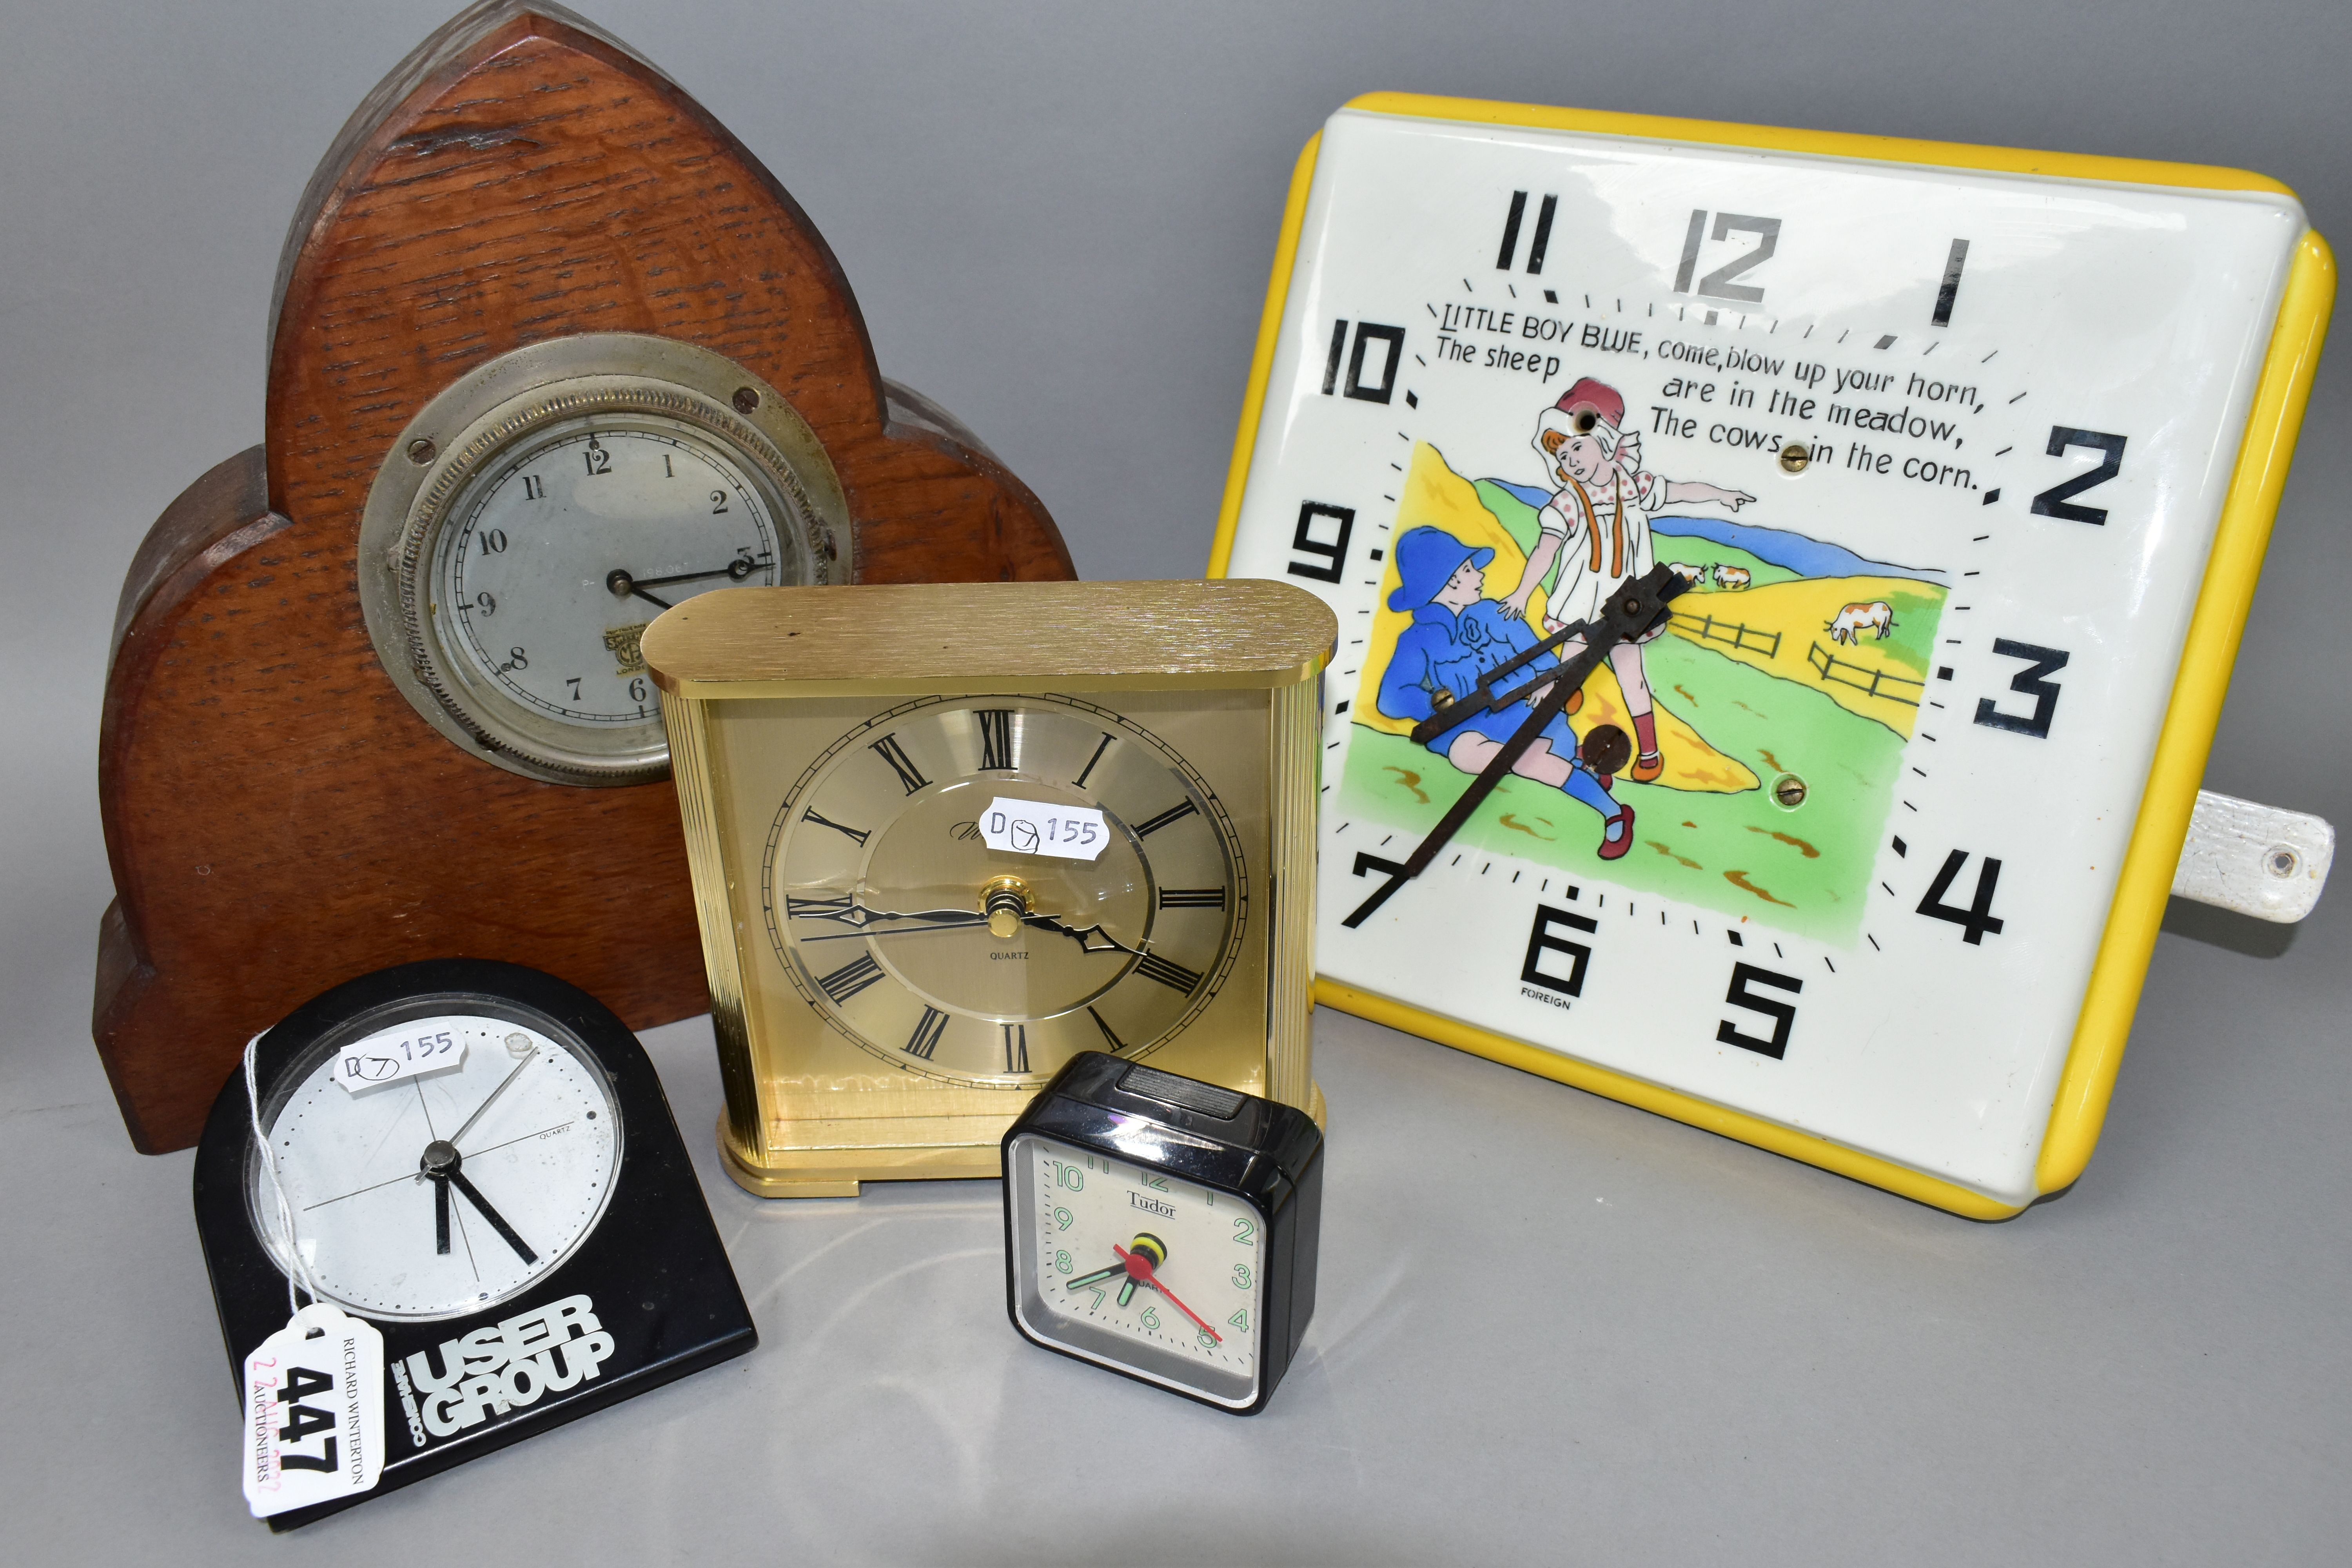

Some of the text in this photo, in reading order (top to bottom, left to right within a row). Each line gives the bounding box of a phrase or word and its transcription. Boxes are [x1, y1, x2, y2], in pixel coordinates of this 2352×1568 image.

[1496, 191, 1557, 274] 11
[1673, 210, 1782, 302] 12
[1931, 239, 1969, 327] 1
[1322, 320, 1405, 405] 10
[1440, 304, 1514, 333] LITTLE
[1522, 316, 1573, 343] BOY
[1581, 323, 1649, 359] BLUE,
[1794, 361, 1826, 391] up
[1833, 367, 1893, 394] your
[1907, 372, 1985, 415] horn,
[1436, 336, 1964, 450] The sheep are in the meadow,
[584, 448, 612, 475] 12
[662, 454, 675, 478] 1
[1651, 407, 1978, 490] The cows in the corn.
[523, 475, 546, 500] 11
[2030, 426, 2128, 526] 2
[710, 490, 728, 514] 2
[479, 529, 507, 556] 10
[1287, 501, 1356, 584] 9
[477, 592, 495, 617] 9
[510, 647, 528, 670] 8
[566, 677, 583, 700] 7
[629, 678, 647, 701] 6
[1973, 638, 2071, 739] 3
[973, 710, 1018, 770] XII
[1072, 732, 1117, 789] I
[868, 733, 933, 797] XI
[801, 806, 871, 847] X
[991, 813, 1005, 833] D
[1048, 818, 1098, 844] 155
[1131, 796, 1200, 841] II
[1160, 886, 1225, 911] III
[1341, 852, 1412, 928] 7
[1916, 849, 2004, 946] 4
[990, 952, 1029, 960] QUARTZ
[1521, 904, 1598, 997] 6
[815, 951, 886, 1007] VIII
[1521, 987, 1570, 1010] FOREIGN
[1087, 1006, 1127, 1053] V
[1716, 961, 1803, 1060] 5
[345, 1059, 361, 1077] D
[400, 1032, 453, 1060] 155
[900, 1005, 950, 1062] VII
[1000, 1025, 1032, 1073] VI
[539, 1125, 572, 1140] QUARTZ
[1053, 1160, 1083, 1192] 10
[1054, 1207, 1073, 1231] 9
[1127, 1191, 1176, 1219] Tudor
[1233, 1218, 1254, 1246] 2
[1055, 1249, 1073, 1274] 8
[1231, 1264, 1252, 1290] 3
[1089, 1287, 1106, 1310] 7
[1141, 1307, 1160, 1329] 6
[1228, 1309, 1248, 1332] 4
[406, 1295, 602, 1393] USER
[1197, 1326, 1217, 1348] 5
[421, 1331, 615, 1436] GROUP
[254, 1385, 269, 1482] AUCTIONEERS
[277, 1367, 339, 1473] 447
[343, 1338, 363, 1485] RICHARD WINTERTON
